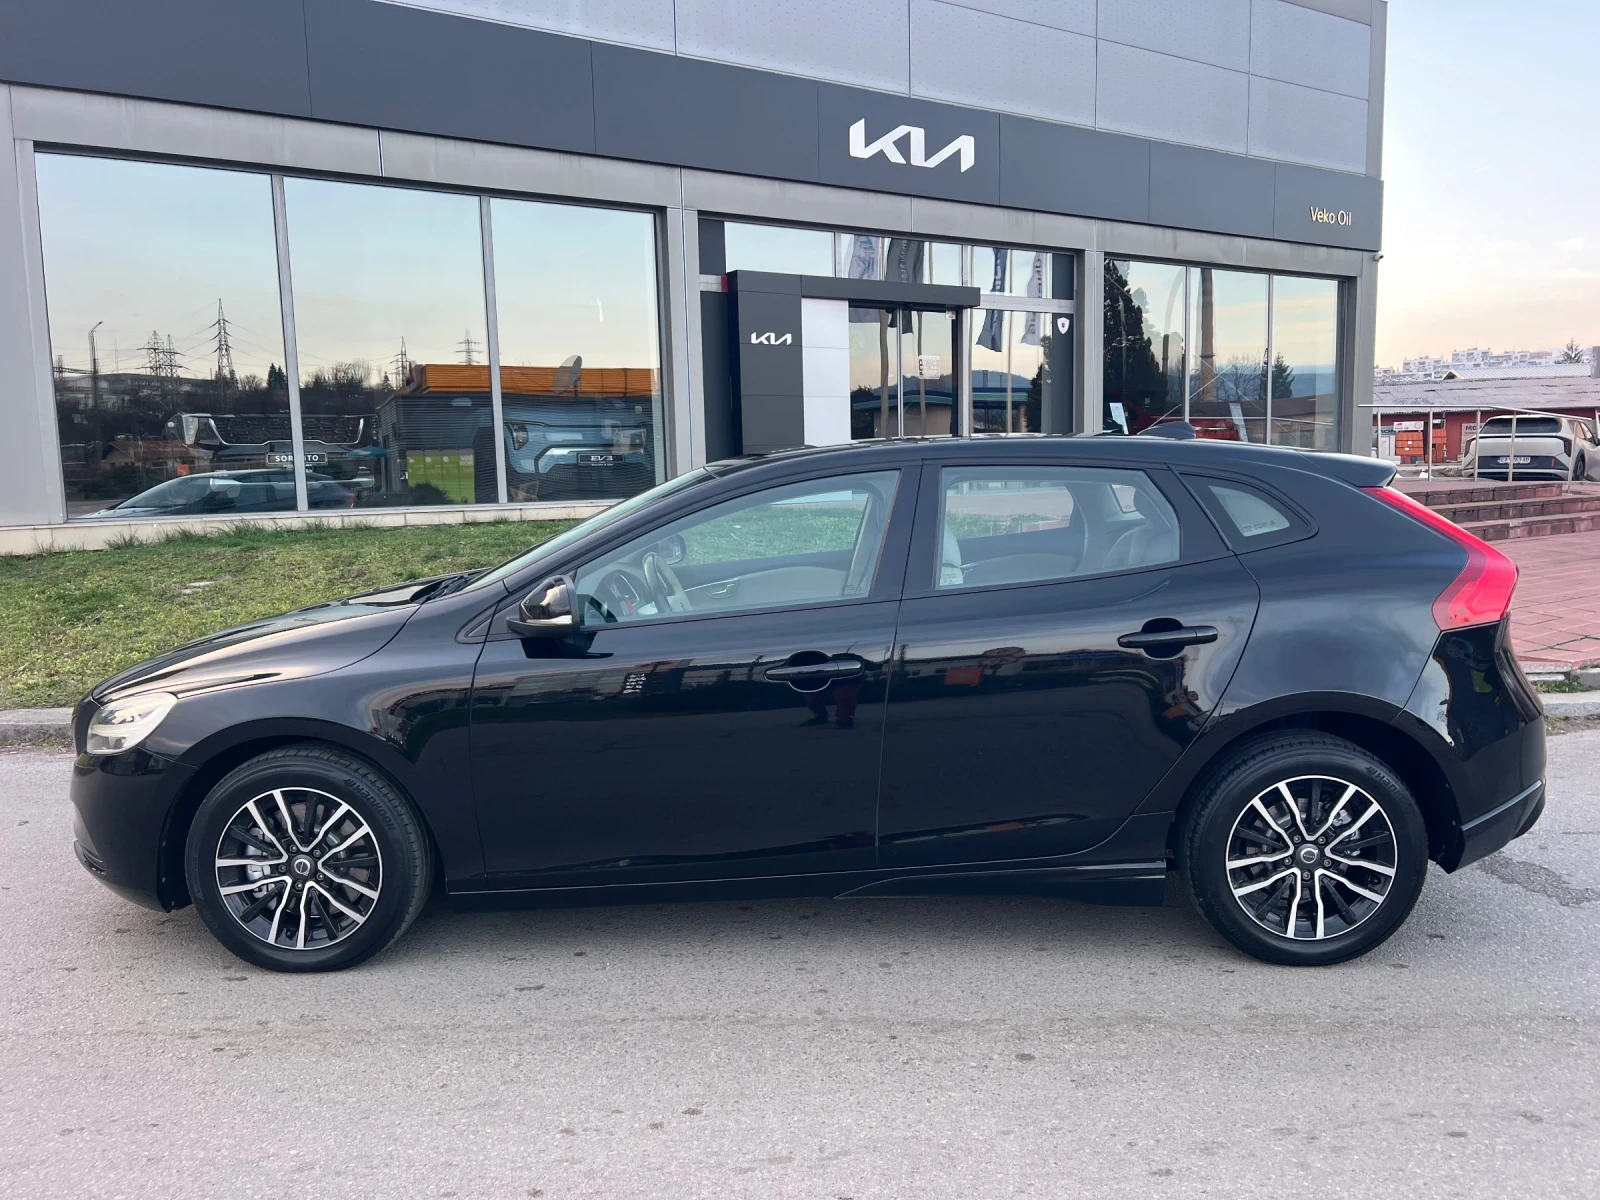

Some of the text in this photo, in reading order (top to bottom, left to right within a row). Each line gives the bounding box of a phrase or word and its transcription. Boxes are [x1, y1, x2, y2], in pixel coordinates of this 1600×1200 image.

[849, 118, 975, 172] KIA
[1310, 206, 1352, 226] Veko Oil
[750, 332, 792, 346] KIA
[275, 454, 319, 462] SORTO
